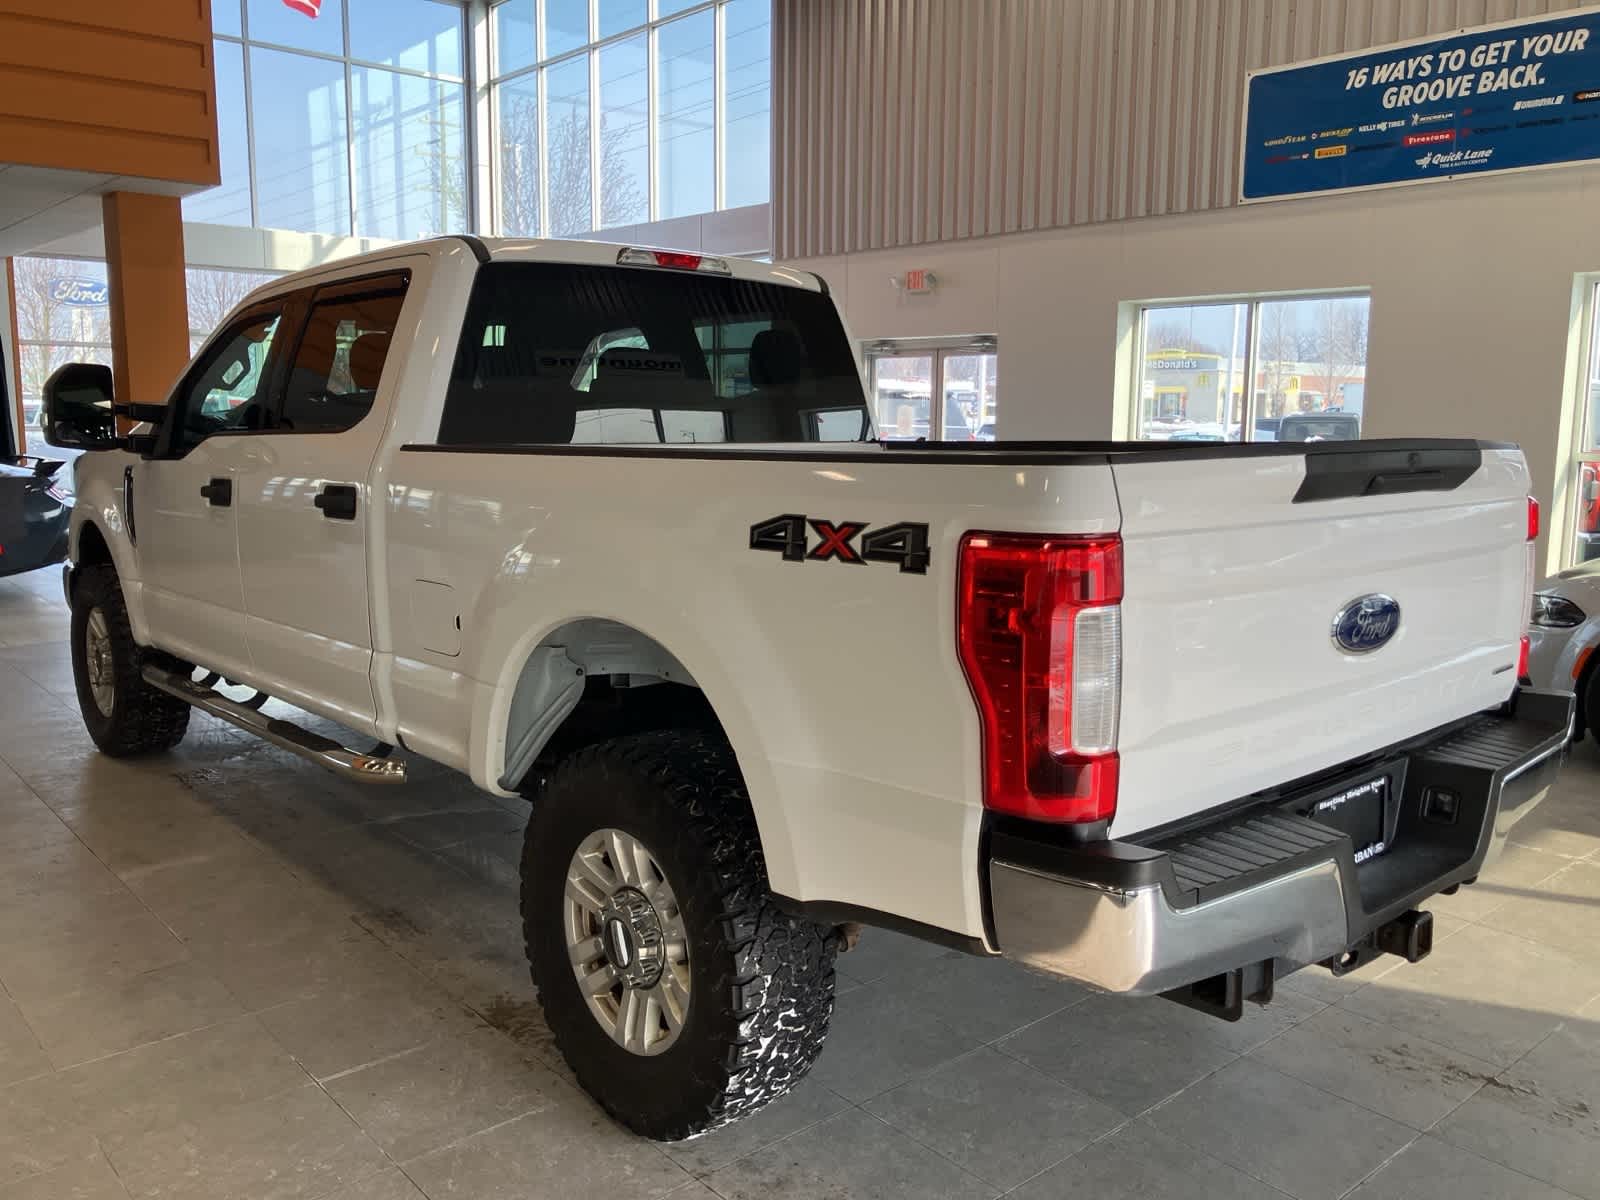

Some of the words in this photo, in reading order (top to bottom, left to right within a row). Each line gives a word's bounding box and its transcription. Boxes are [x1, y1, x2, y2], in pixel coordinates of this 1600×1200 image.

[1345, 67, 1368, 91] 16
[1372, 52, 1433, 86] WAYS
[1437, 49, 1466, 74] TO
[1470, 39, 1516, 68] GET
[1521, 28, 1590, 60] YOUR
[1382, 73, 1475, 109] GROOVE
[1477, 62, 1545, 95] BACK.
[1408, 133, 1451, 145] Firestone
[1432, 151, 1463, 164] Quick
[1464, 149, 1493, 160] Lane
[54, 281, 106, 302] Ford
[1351, 608, 1392, 643] Ford
